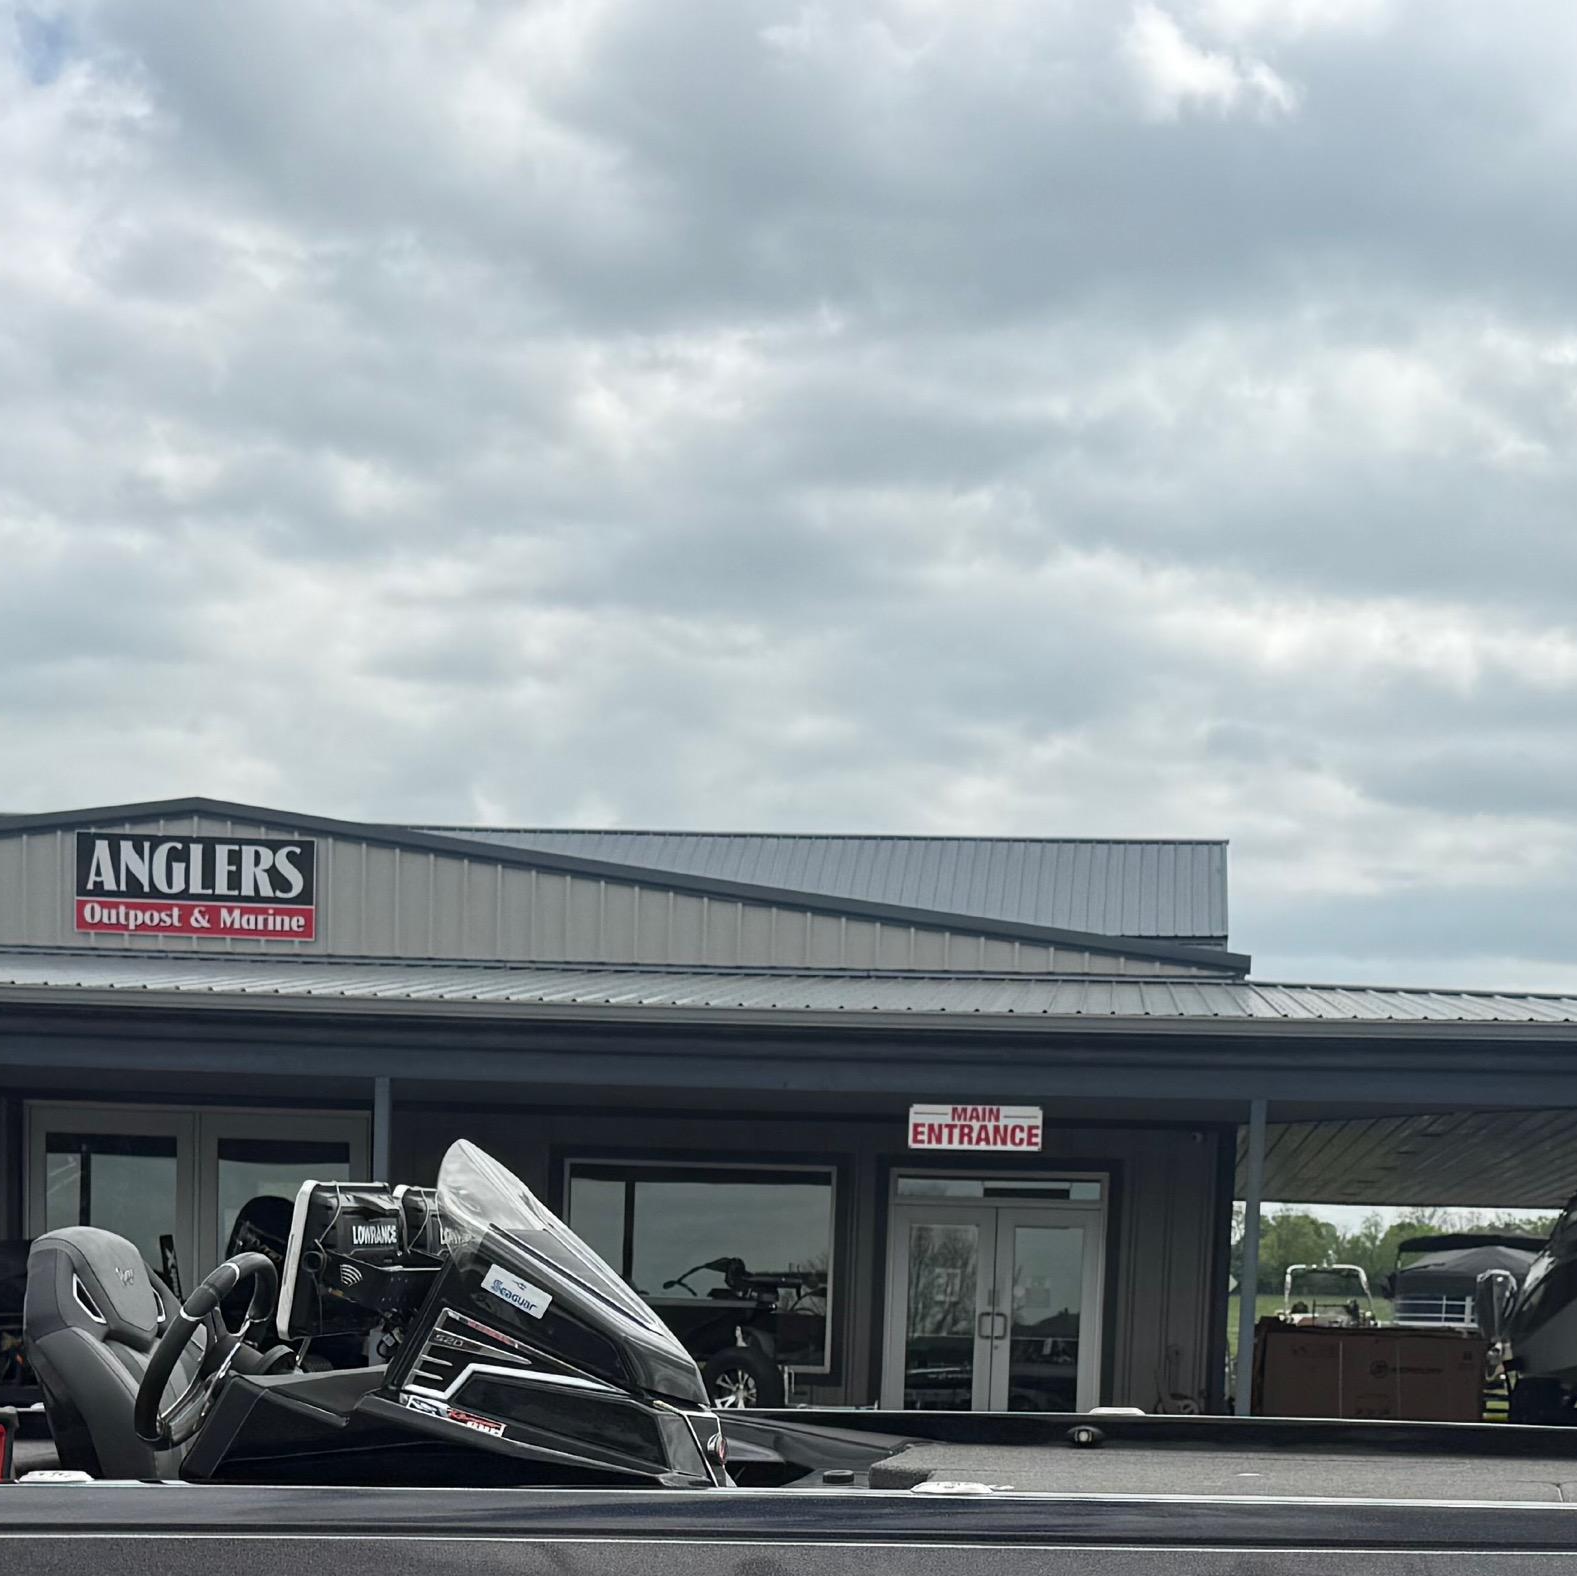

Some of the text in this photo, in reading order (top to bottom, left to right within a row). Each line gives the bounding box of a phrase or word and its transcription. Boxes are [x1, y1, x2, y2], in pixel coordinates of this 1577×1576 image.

[85, 839, 305, 899] ANGLERS
[83, 902, 306, 932] Outpost & Marine
[951, 1106, 1001, 1123] MAIN
[911, 1122, 1040, 1147] ENTRANCE
[352, 1225, 398, 1245] LOWRANCE
[490, 1278, 538, 1312] Seaguar
